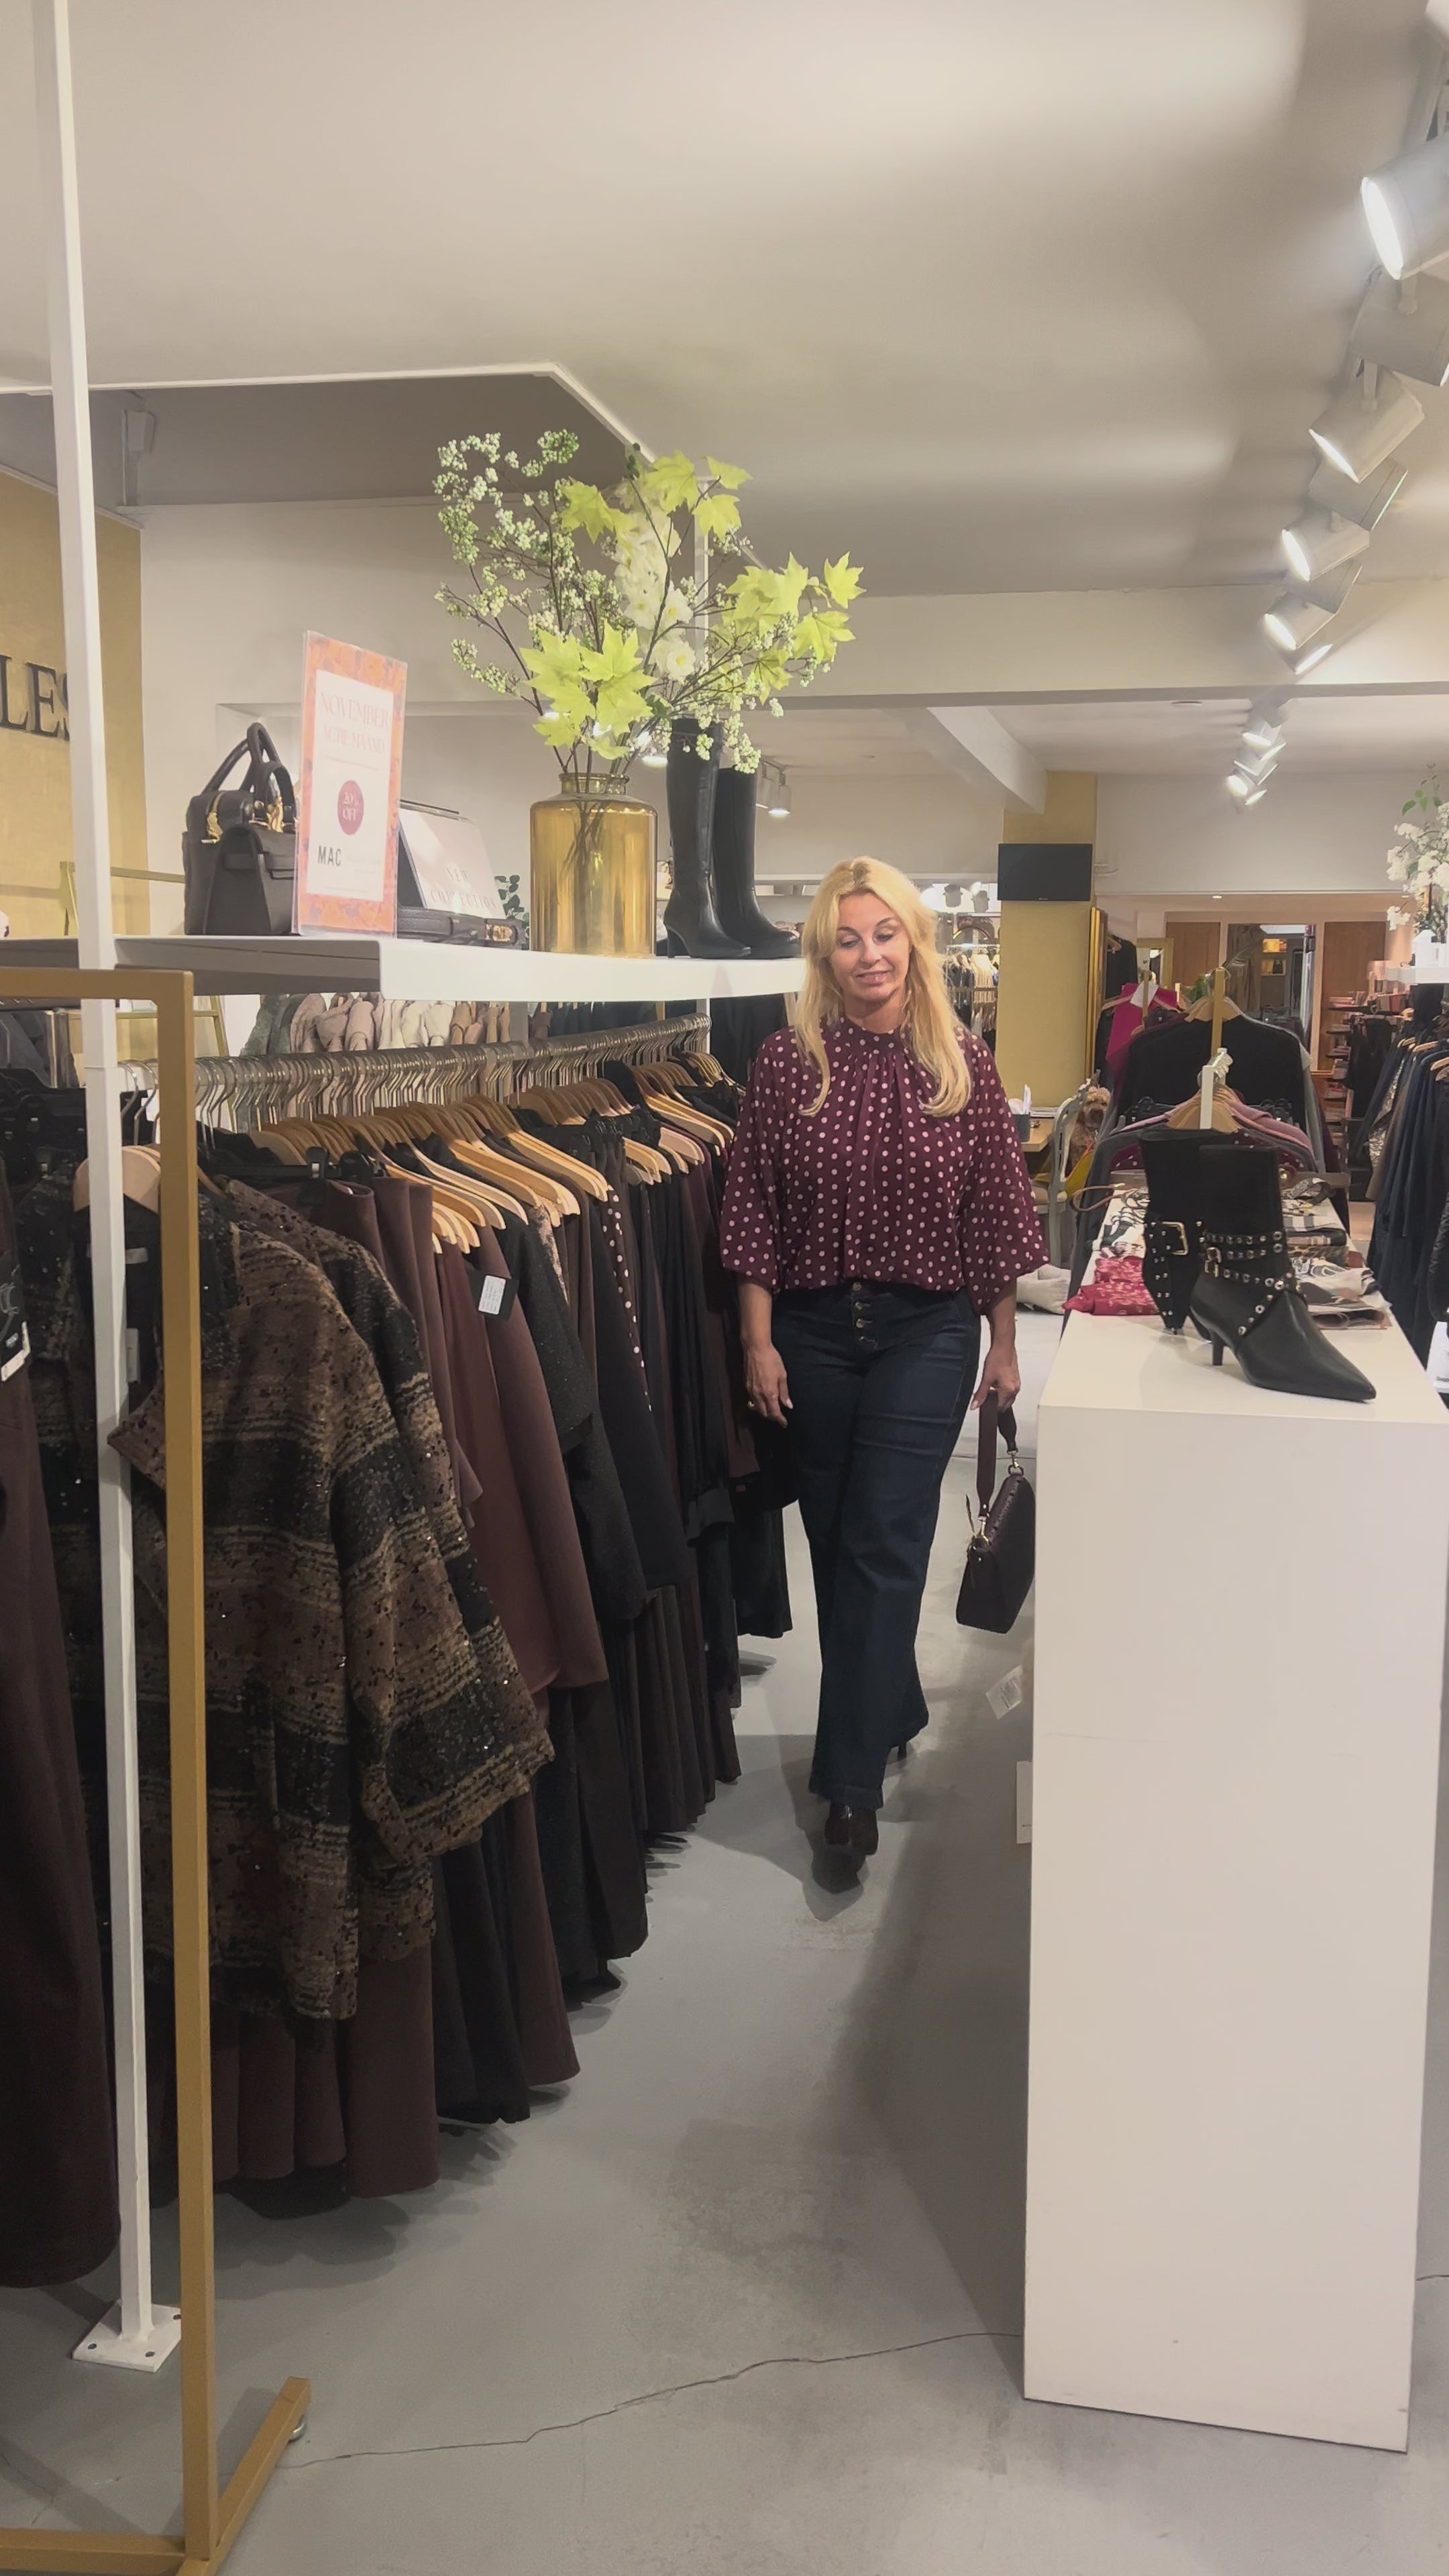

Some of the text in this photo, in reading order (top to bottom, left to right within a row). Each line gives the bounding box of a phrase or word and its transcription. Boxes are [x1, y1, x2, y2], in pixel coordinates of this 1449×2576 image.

[0, 654, 70, 741] LE
[321, 692, 388, 730] NOVEMBER
[317, 845, 341, 867] MAC
[445, 867, 469, 882] NEW
[430, 890, 496, 908] COLECTION
